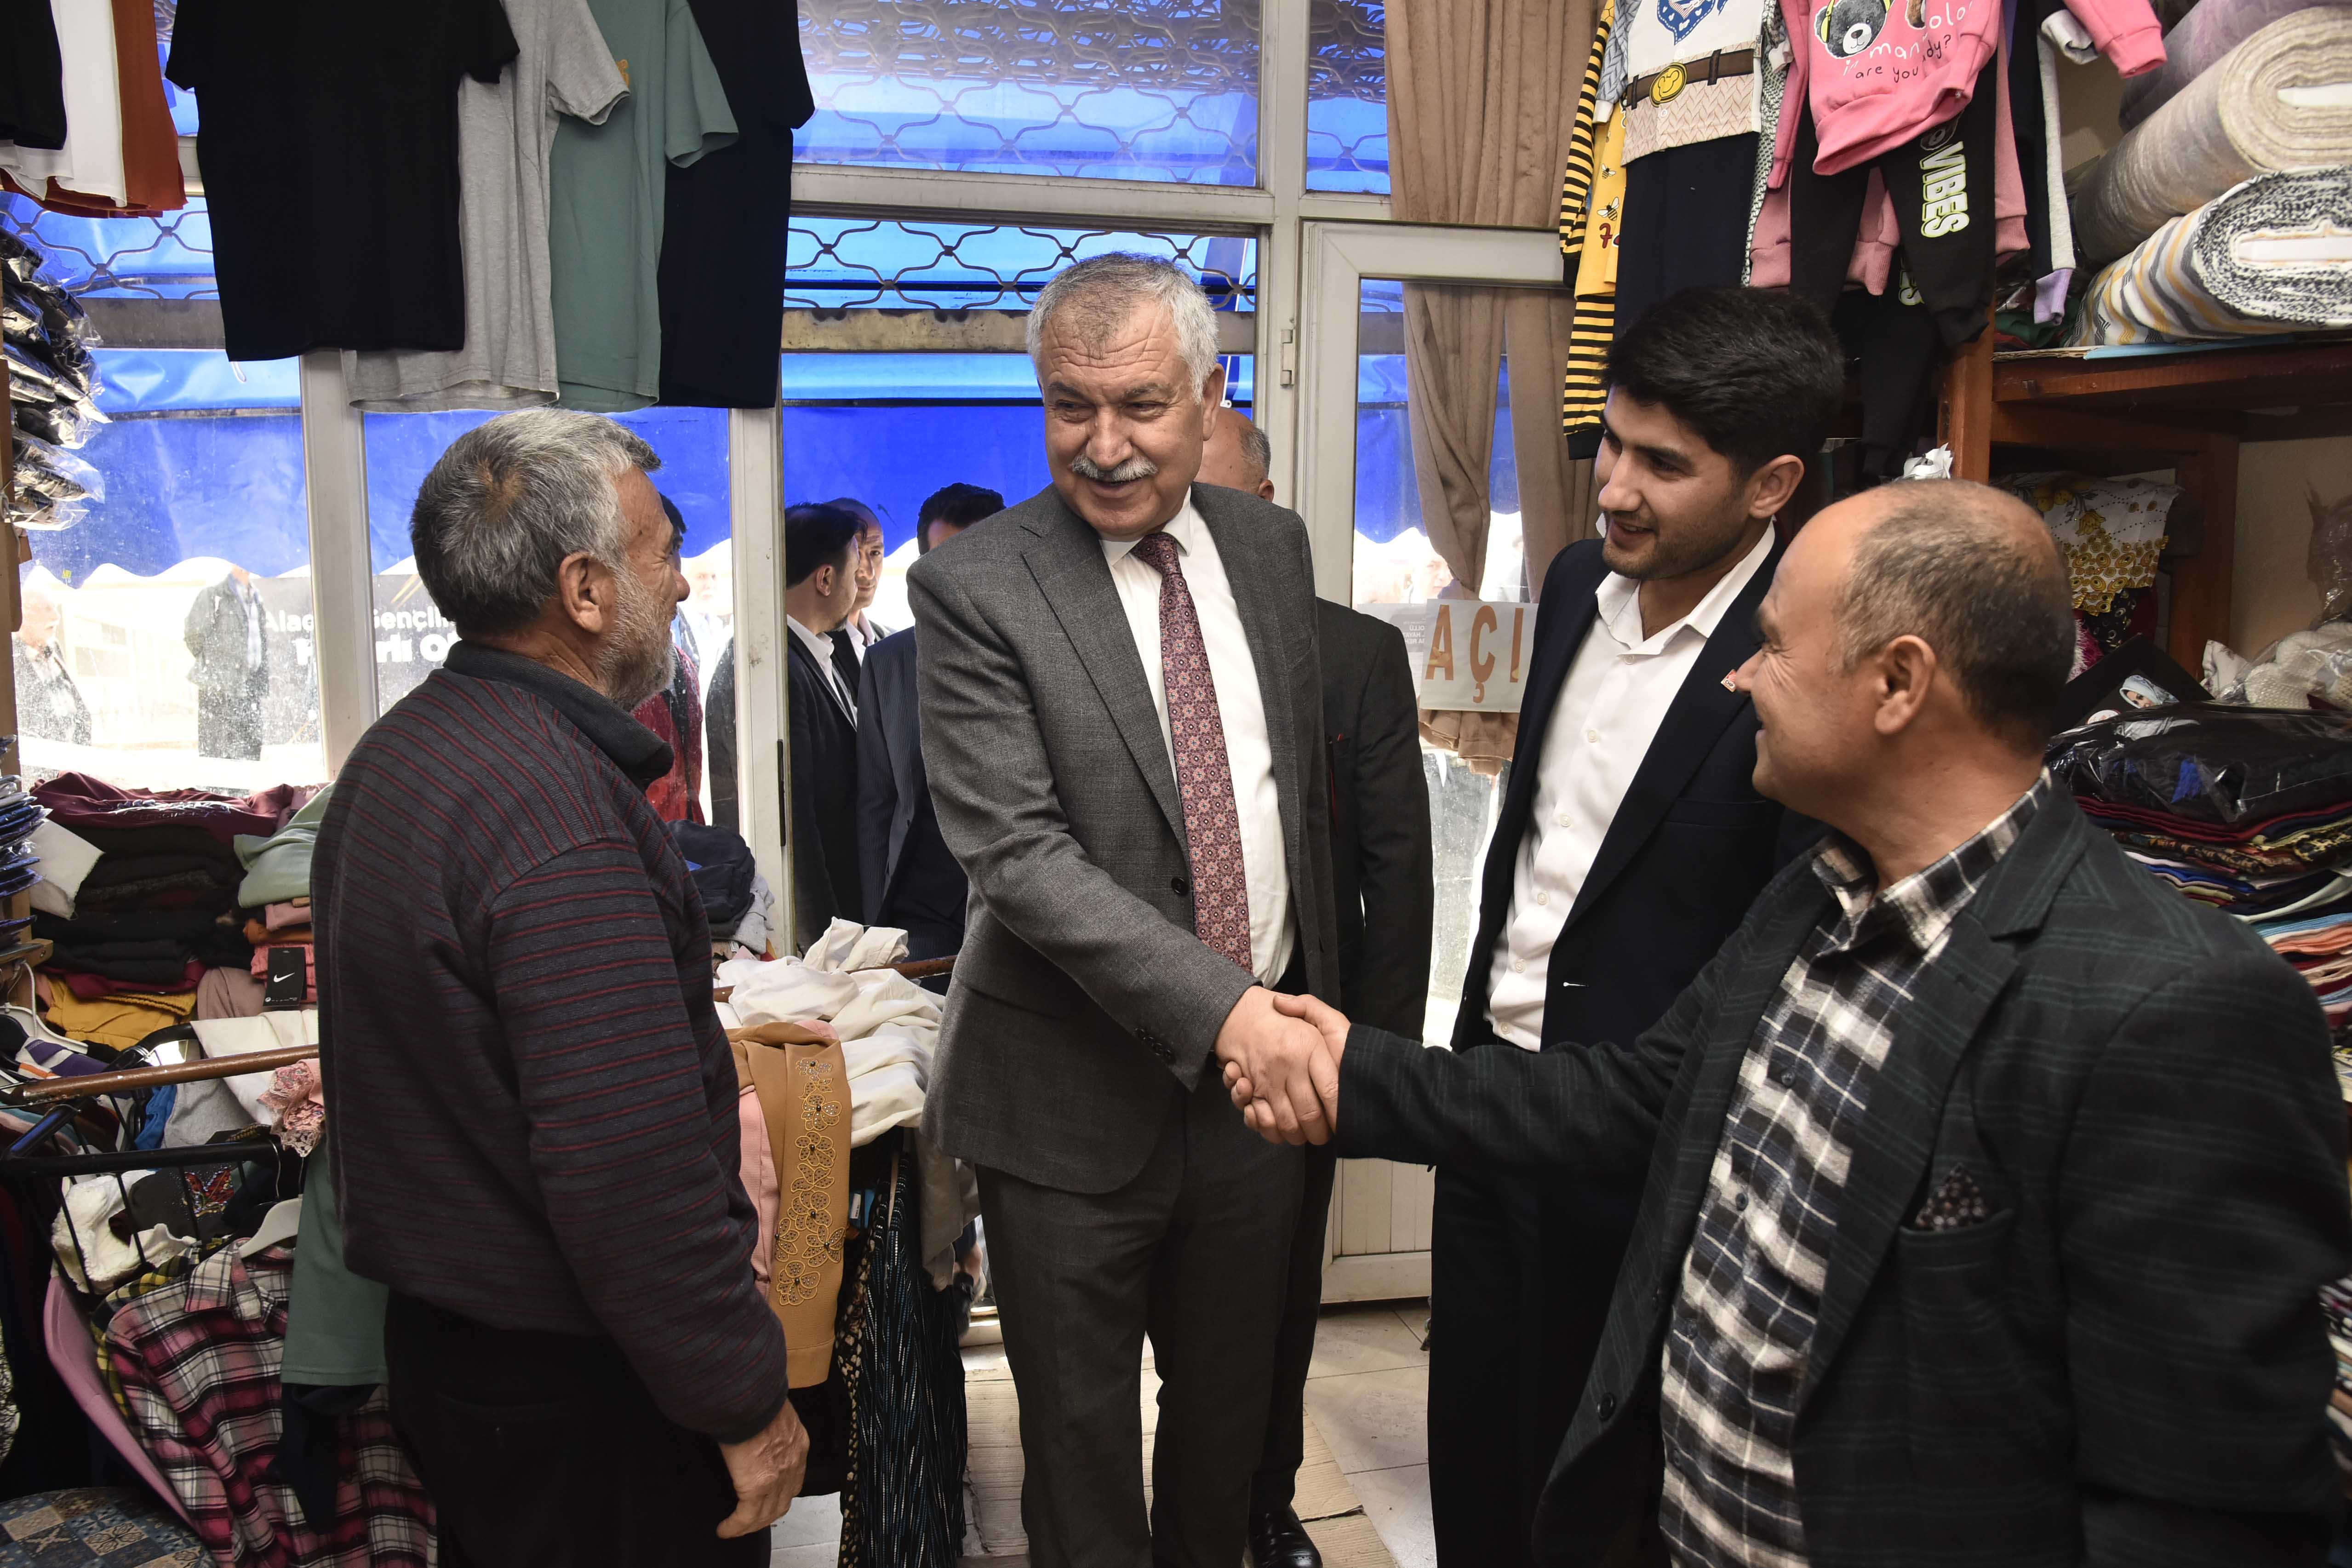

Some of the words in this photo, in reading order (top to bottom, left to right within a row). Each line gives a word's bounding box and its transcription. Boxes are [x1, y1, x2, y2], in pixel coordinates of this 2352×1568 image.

[1855, 66, 1883, 79] are
[1893, 66, 1918, 83] you
[1920, 140, 1969, 238] VIBES
